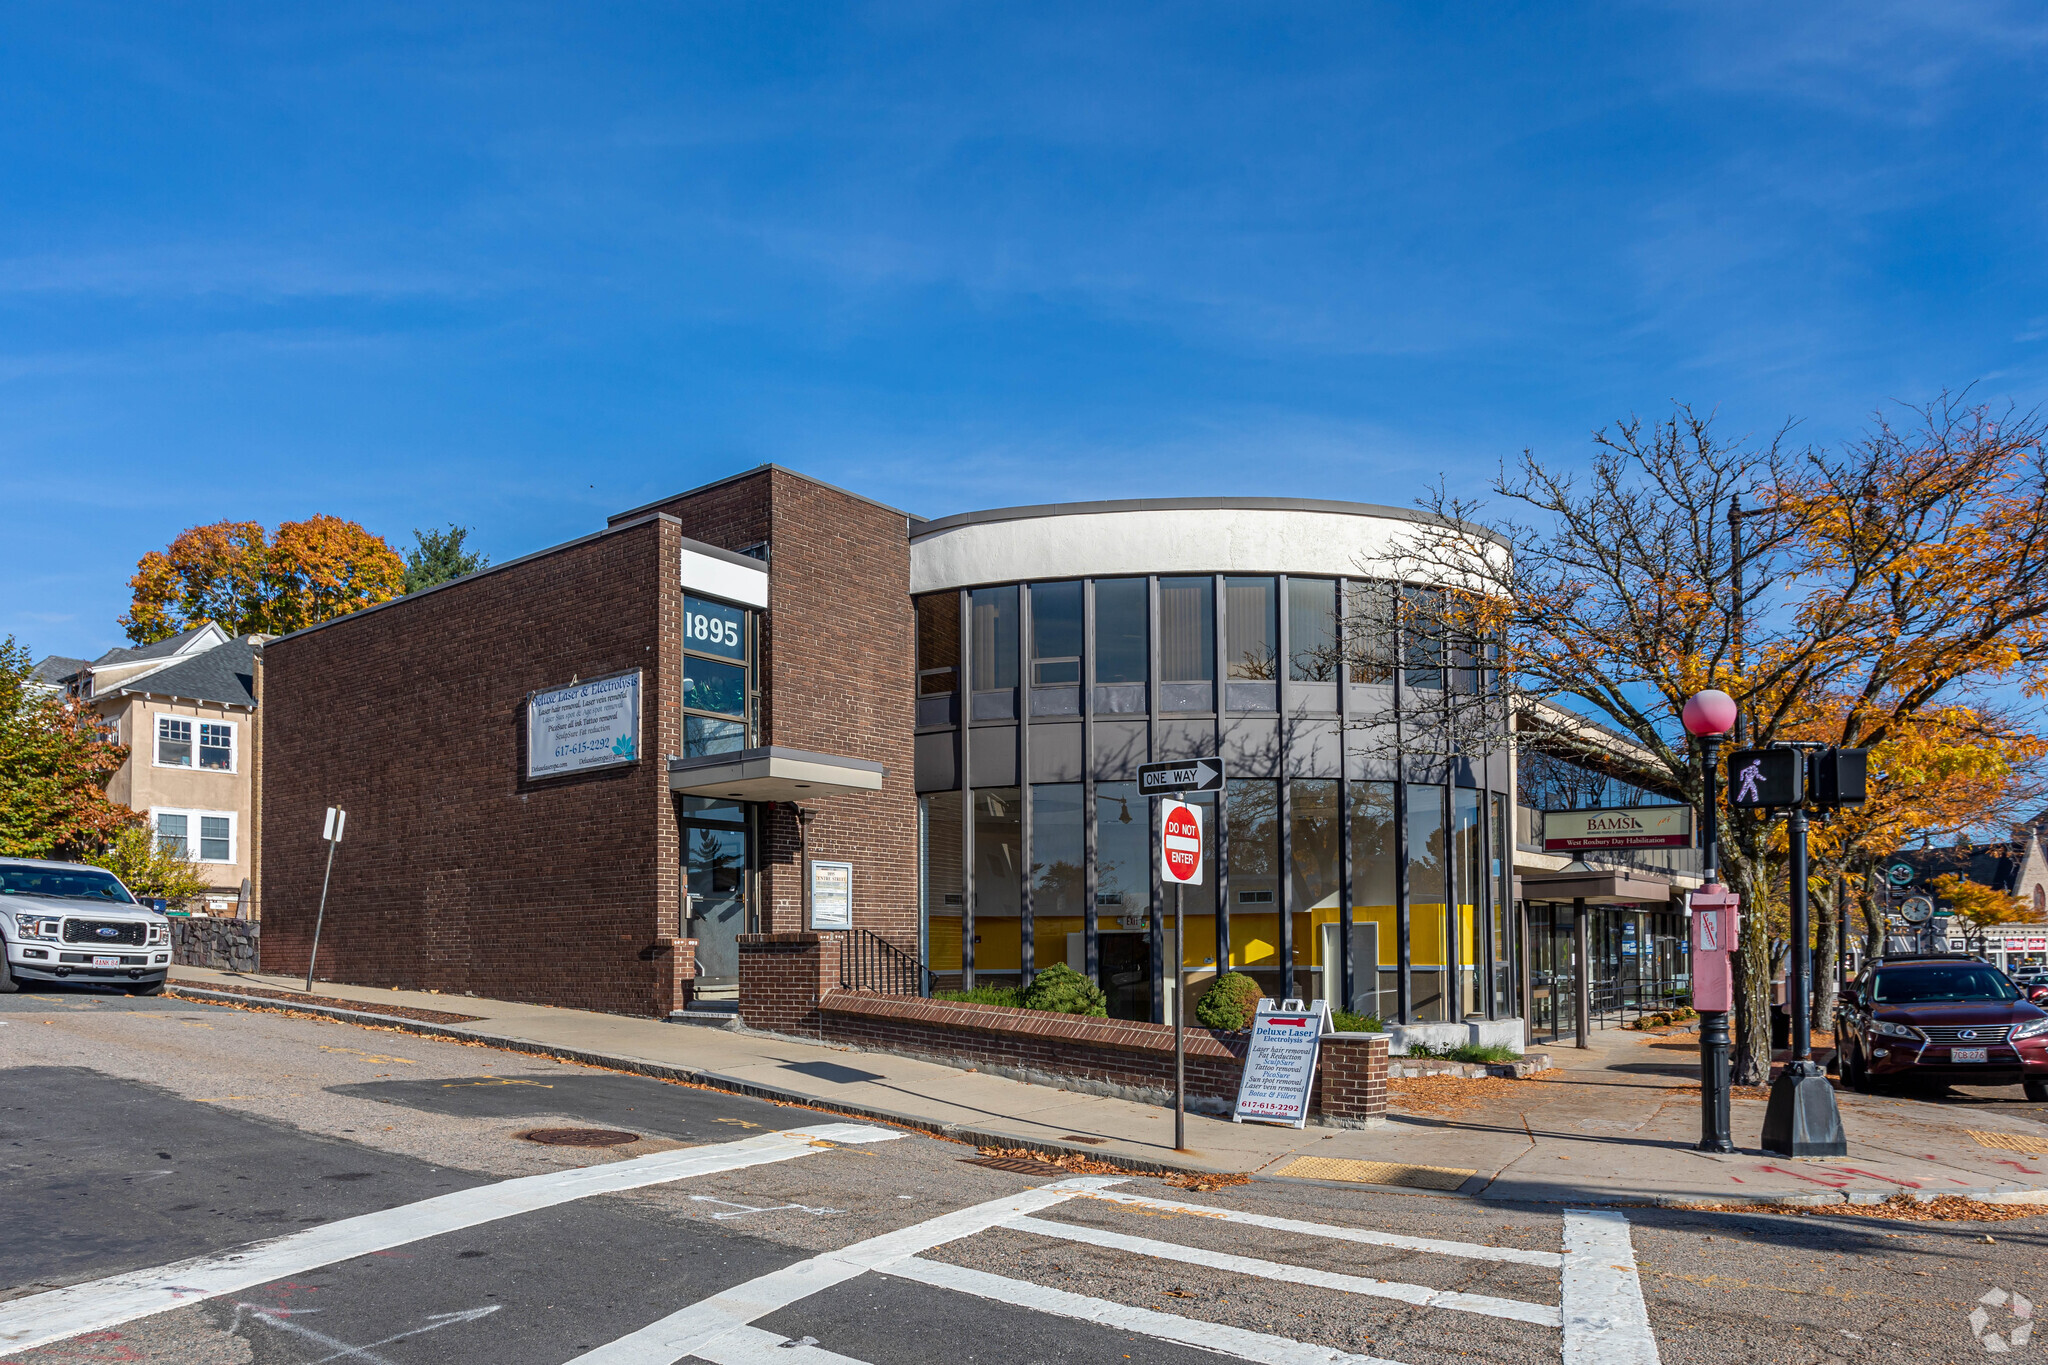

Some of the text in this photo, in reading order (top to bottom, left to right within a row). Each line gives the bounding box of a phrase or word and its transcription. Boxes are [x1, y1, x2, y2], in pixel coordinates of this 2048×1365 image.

[686, 612, 738, 646] 1895
[532, 675, 638, 708] Deluxe Laser & Electrolysis
[552, 705, 561, 713] hair
[582, 700, 596, 708] Laser
[608, 690, 628, 702] removal
[556, 713, 564, 721] Sun
[566, 710, 576, 720] spot
[582, 708, 592, 718] Age
[592, 705, 603, 716] spot
[604, 702, 624, 712] removal
[574, 719, 582, 727] ink
[584, 716, 598, 726] Tattoo
[599, 712, 618, 722] removal
[556, 730, 578, 741] SculpSure
[588, 724, 610, 734] reduction
[555, 738, 610, 757] 617-615-2292
[1146, 770, 1197, 785] ONE WAY
[1168, 822, 1196, 836] DO NOT
[1586, 817, 1636, 830] BAMSI
[1172, 852, 1194, 864] ENTER
[1126, 916, 1138, 926] EXIT
[1264, 1036, 1302, 1044] Electrolysis
[1263, 1058, 1294, 1066] SculpSure
[1242, 1100, 1299, 1112] 617-615-2292
